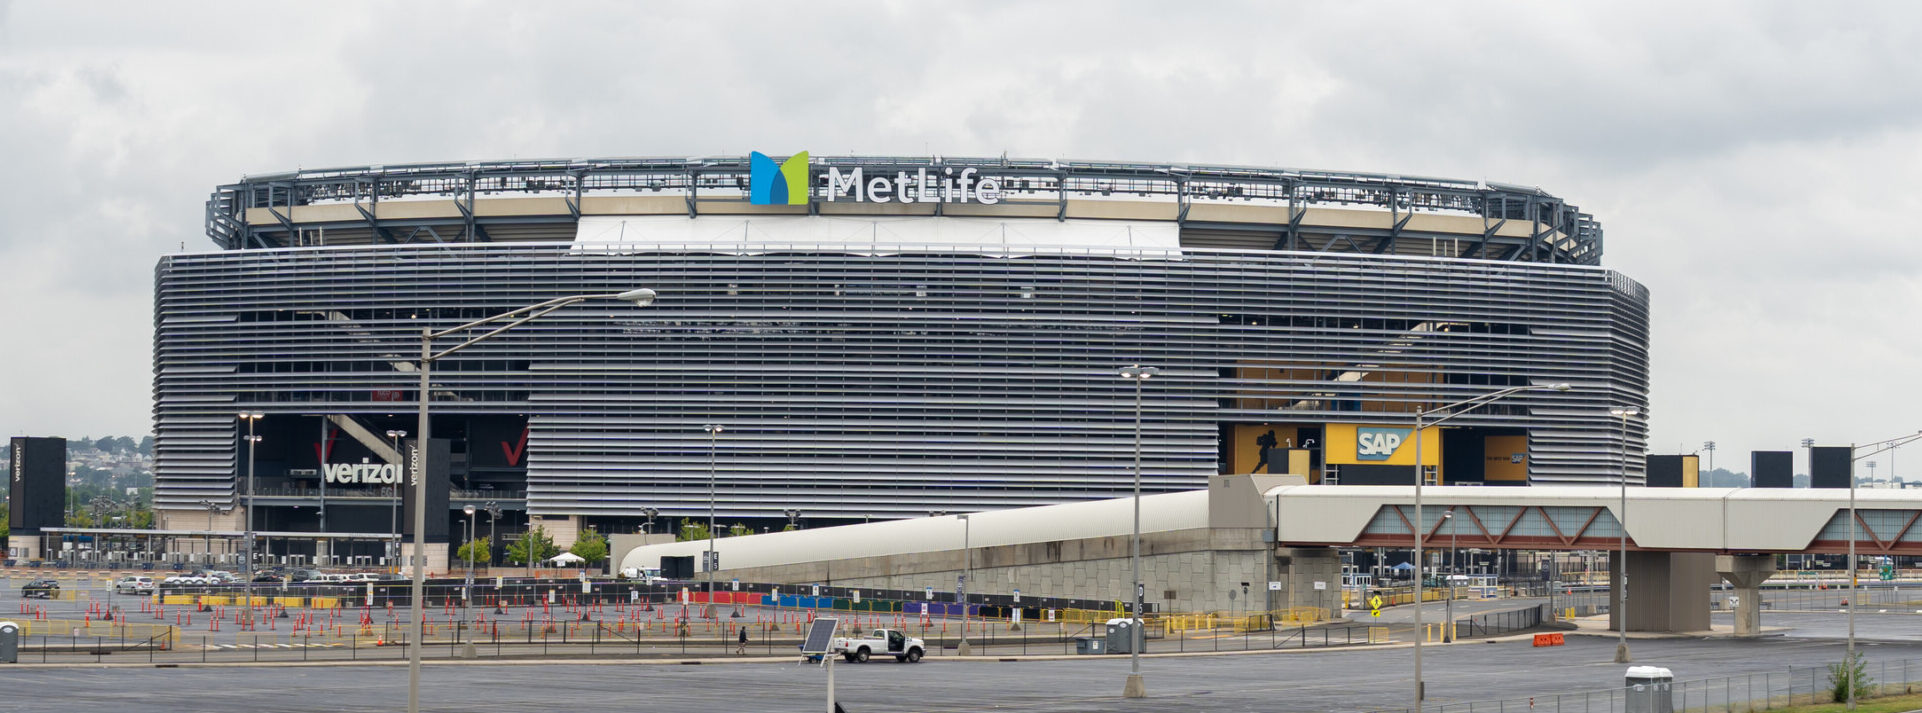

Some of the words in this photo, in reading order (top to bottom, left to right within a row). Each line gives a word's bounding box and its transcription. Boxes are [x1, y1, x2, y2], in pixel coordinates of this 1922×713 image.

[827, 166, 1000, 205] MetLife
[1358, 432, 1401, 456] SAP
[409, 448, 419, 486] verizon
[1139, 603, 1143, 614] 5
